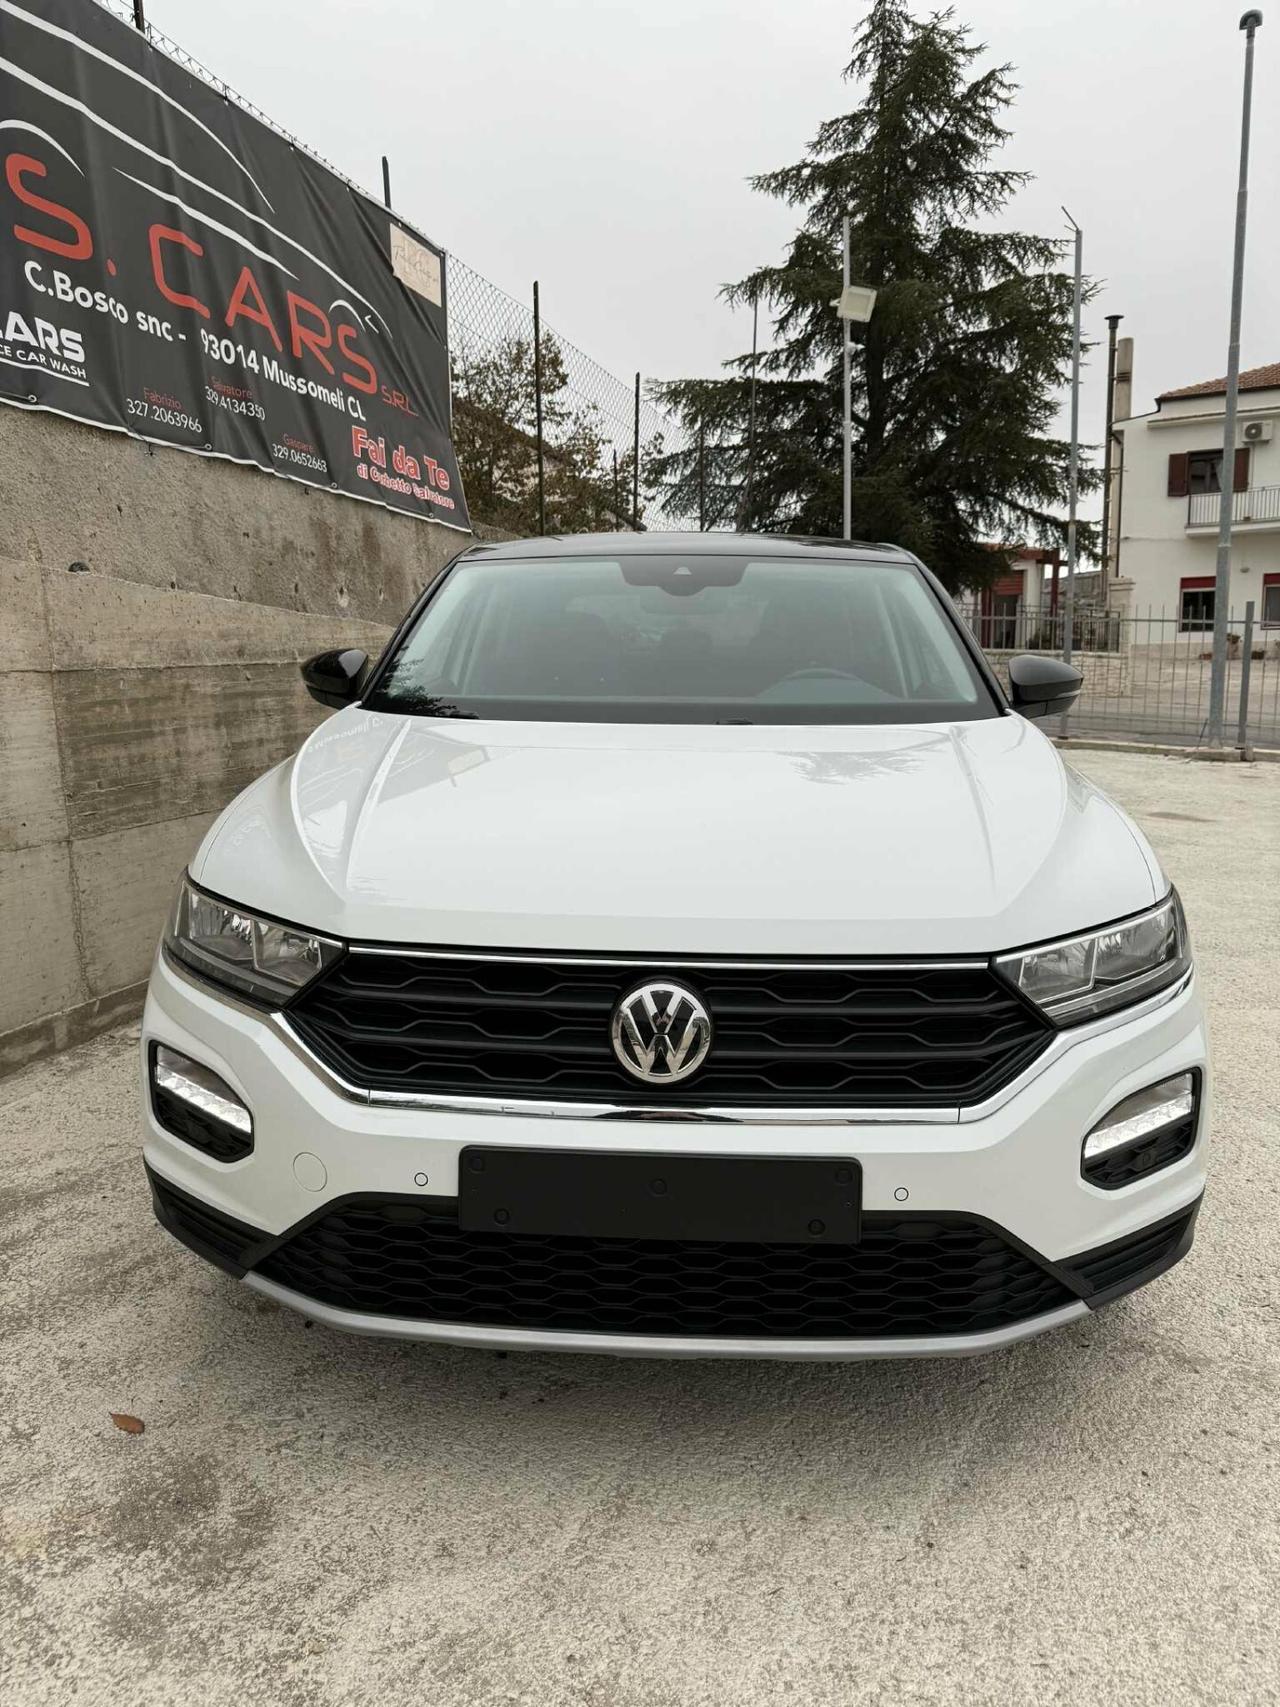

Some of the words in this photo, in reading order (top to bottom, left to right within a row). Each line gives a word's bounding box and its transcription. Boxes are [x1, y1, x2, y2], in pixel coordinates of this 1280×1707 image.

[149, 224, 378, 394] CARS
[0, 311, 86, 363] ARS
[24, 260, 129, 324] C.Bosco
[136, 311, 173, 341] snc
[200, 328, 260, 374] 93014
[262, 355, 345, 412] Mussomeli
[348, 396, 366, 421] CL
[16, 349, 47, 365] CAR
[50, 358, 87, 379] WASH
[126, 398, 202, 433] 327.2063966
[272, 443, 328, 473] 329.0652663
[352, 425, 387, 468] Fai
[392, 445, 421, 480] da
[424, 454, 450, 491] Te
[357, 463, 369, 480] di
